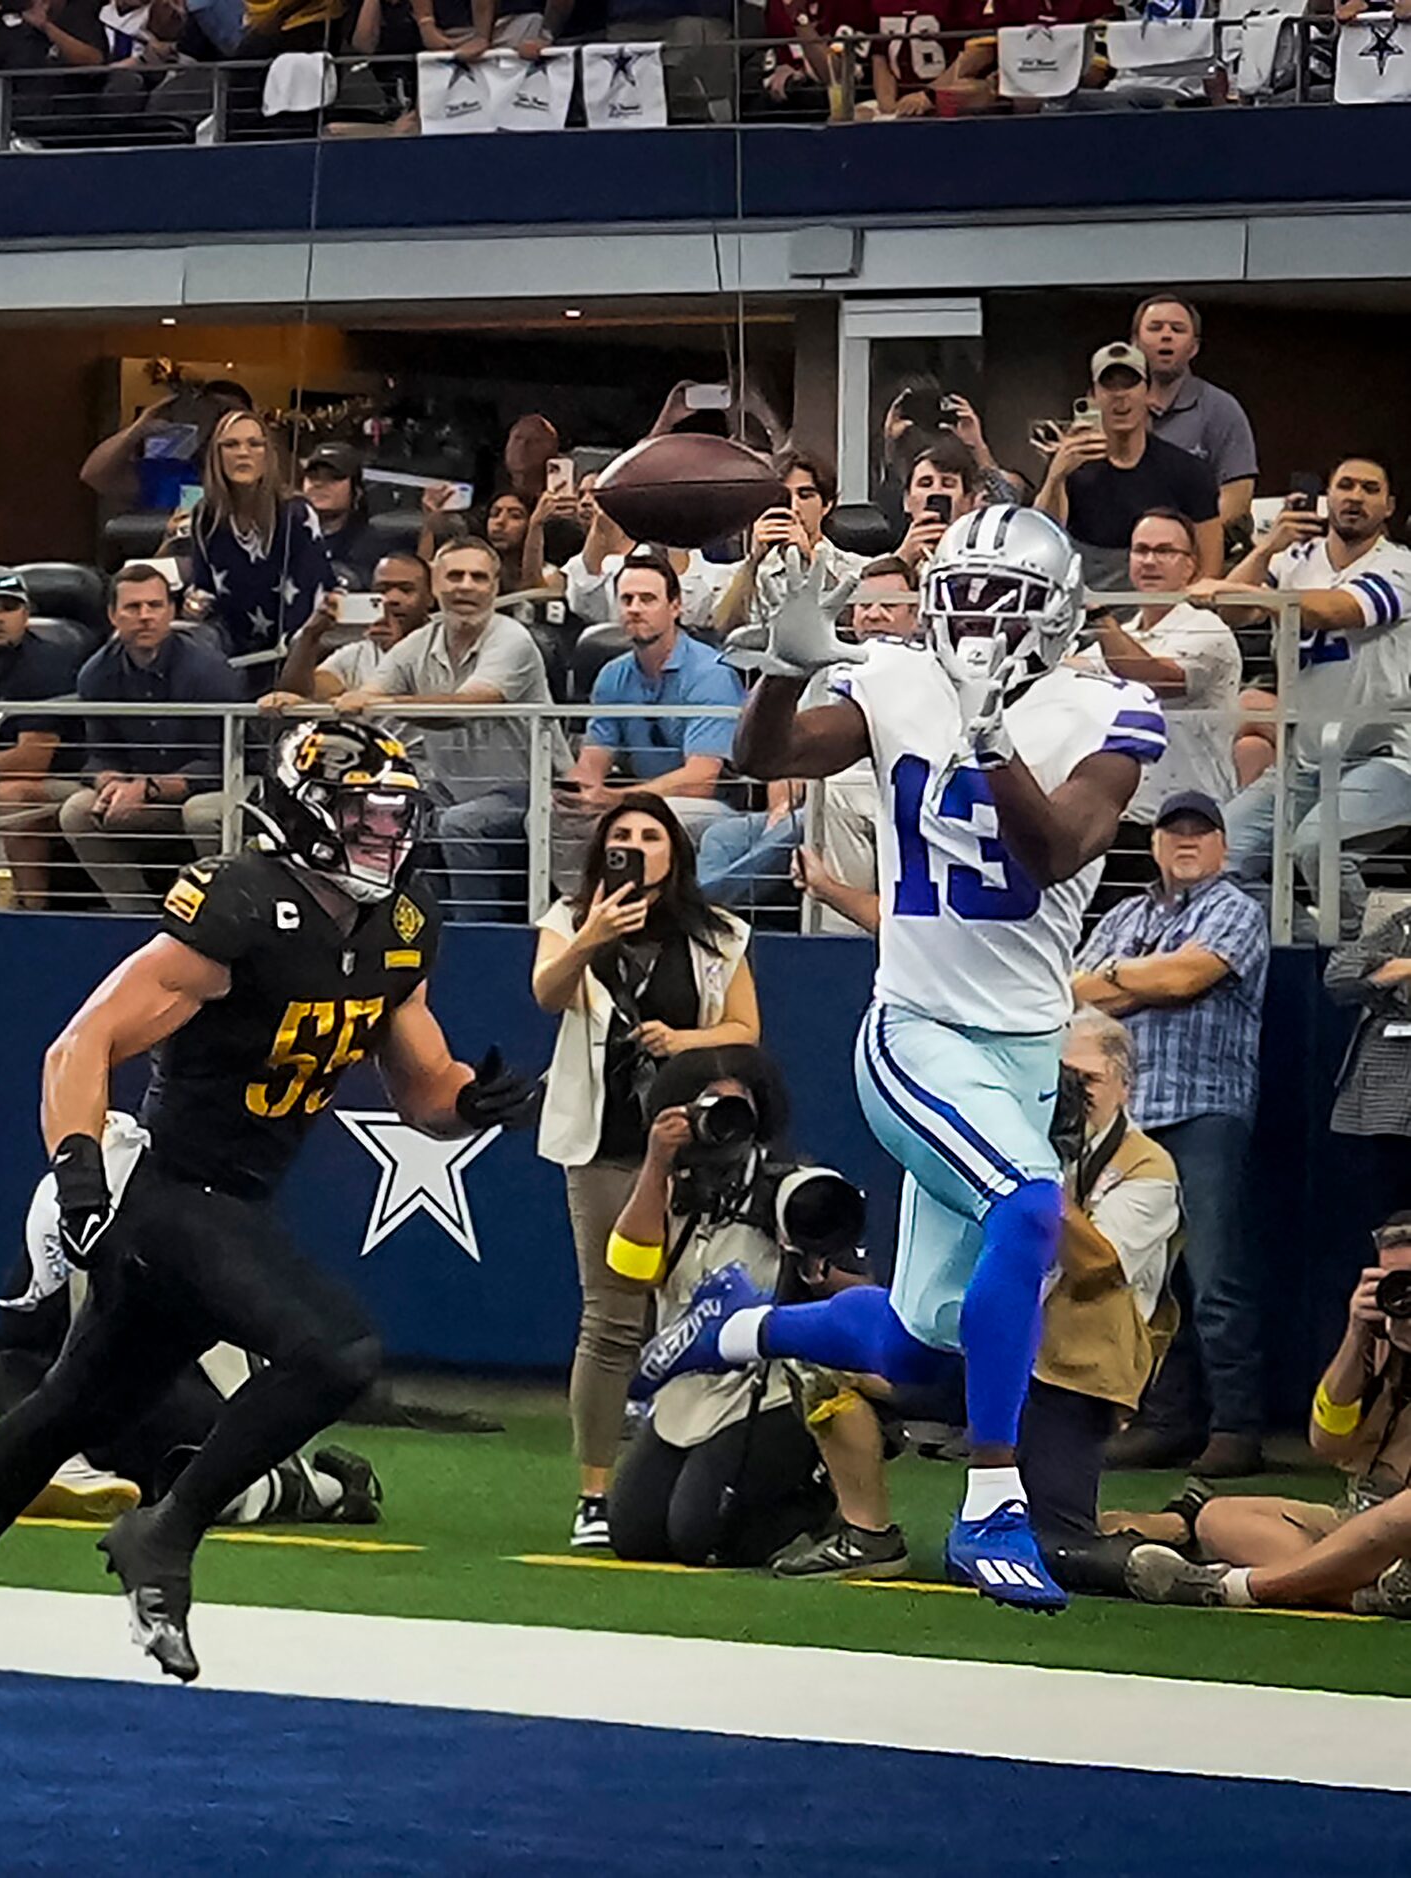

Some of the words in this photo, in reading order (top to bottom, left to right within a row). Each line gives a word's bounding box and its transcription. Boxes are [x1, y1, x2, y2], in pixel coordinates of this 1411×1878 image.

[891, 754, 1041, 920] 13
[276, 901, 301, 929] C
[245, 997, 385, 1118] 55
